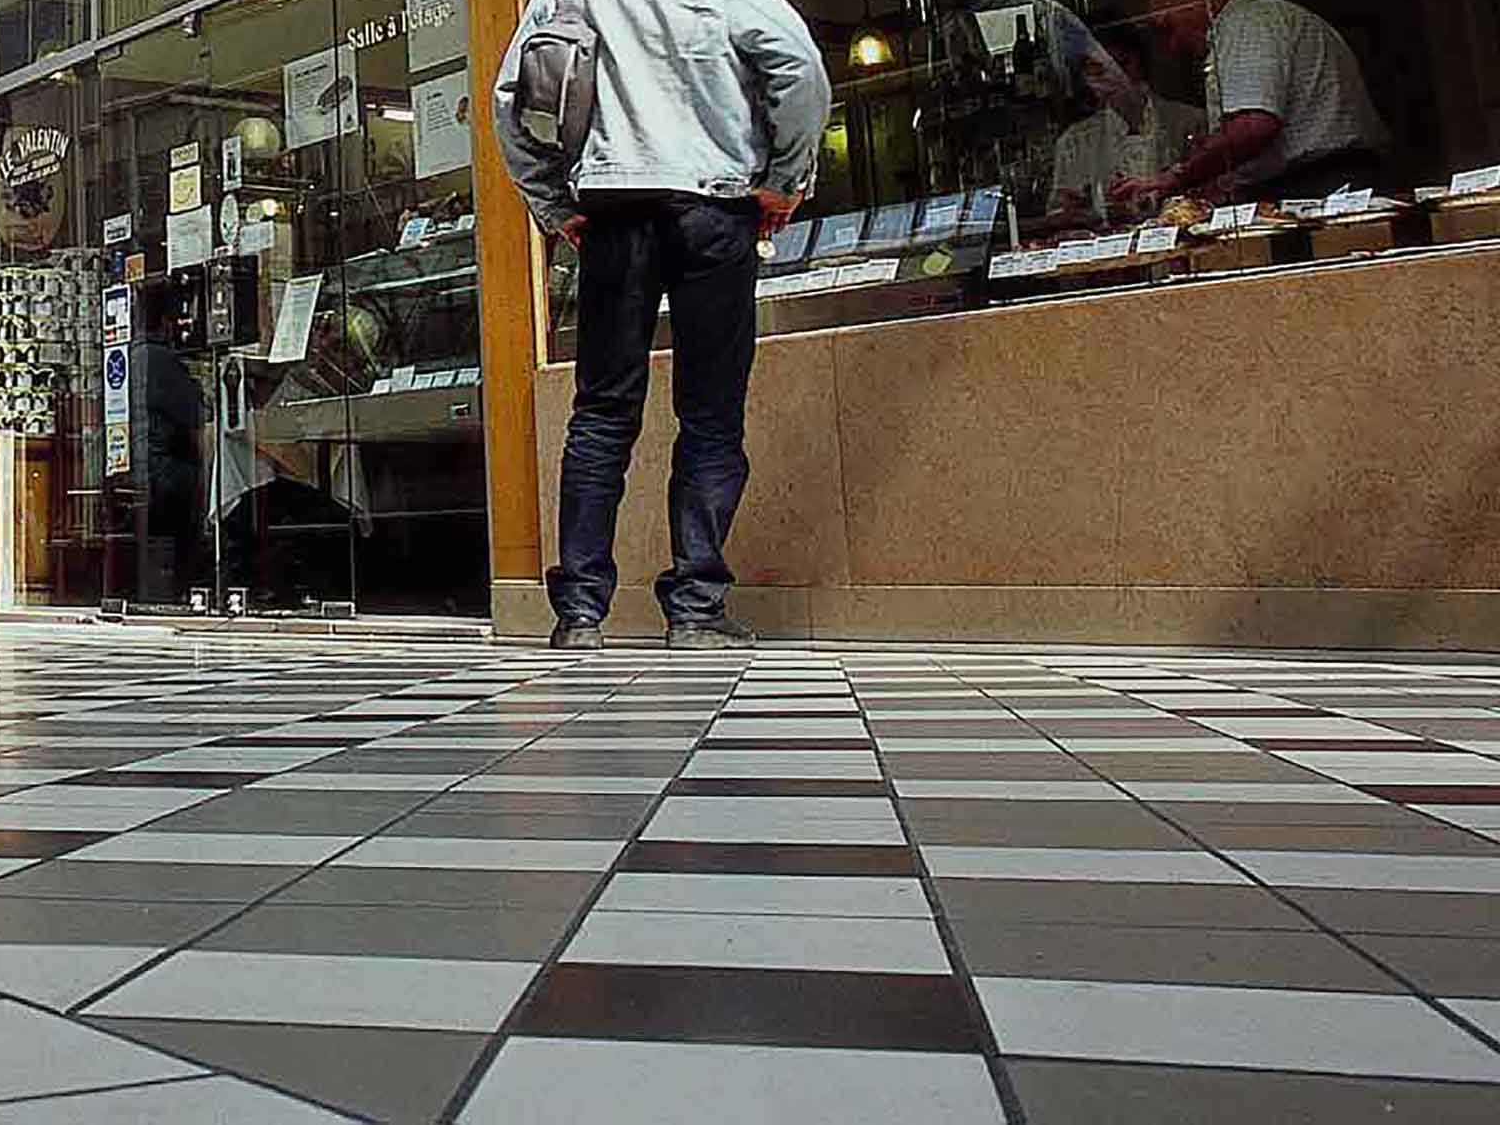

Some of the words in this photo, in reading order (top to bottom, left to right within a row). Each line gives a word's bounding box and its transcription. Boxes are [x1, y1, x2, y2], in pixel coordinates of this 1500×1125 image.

[347, 20, 385, 51] Salle
[387, 15, 397, 37] à
[0, 150, 15, 179] LE
